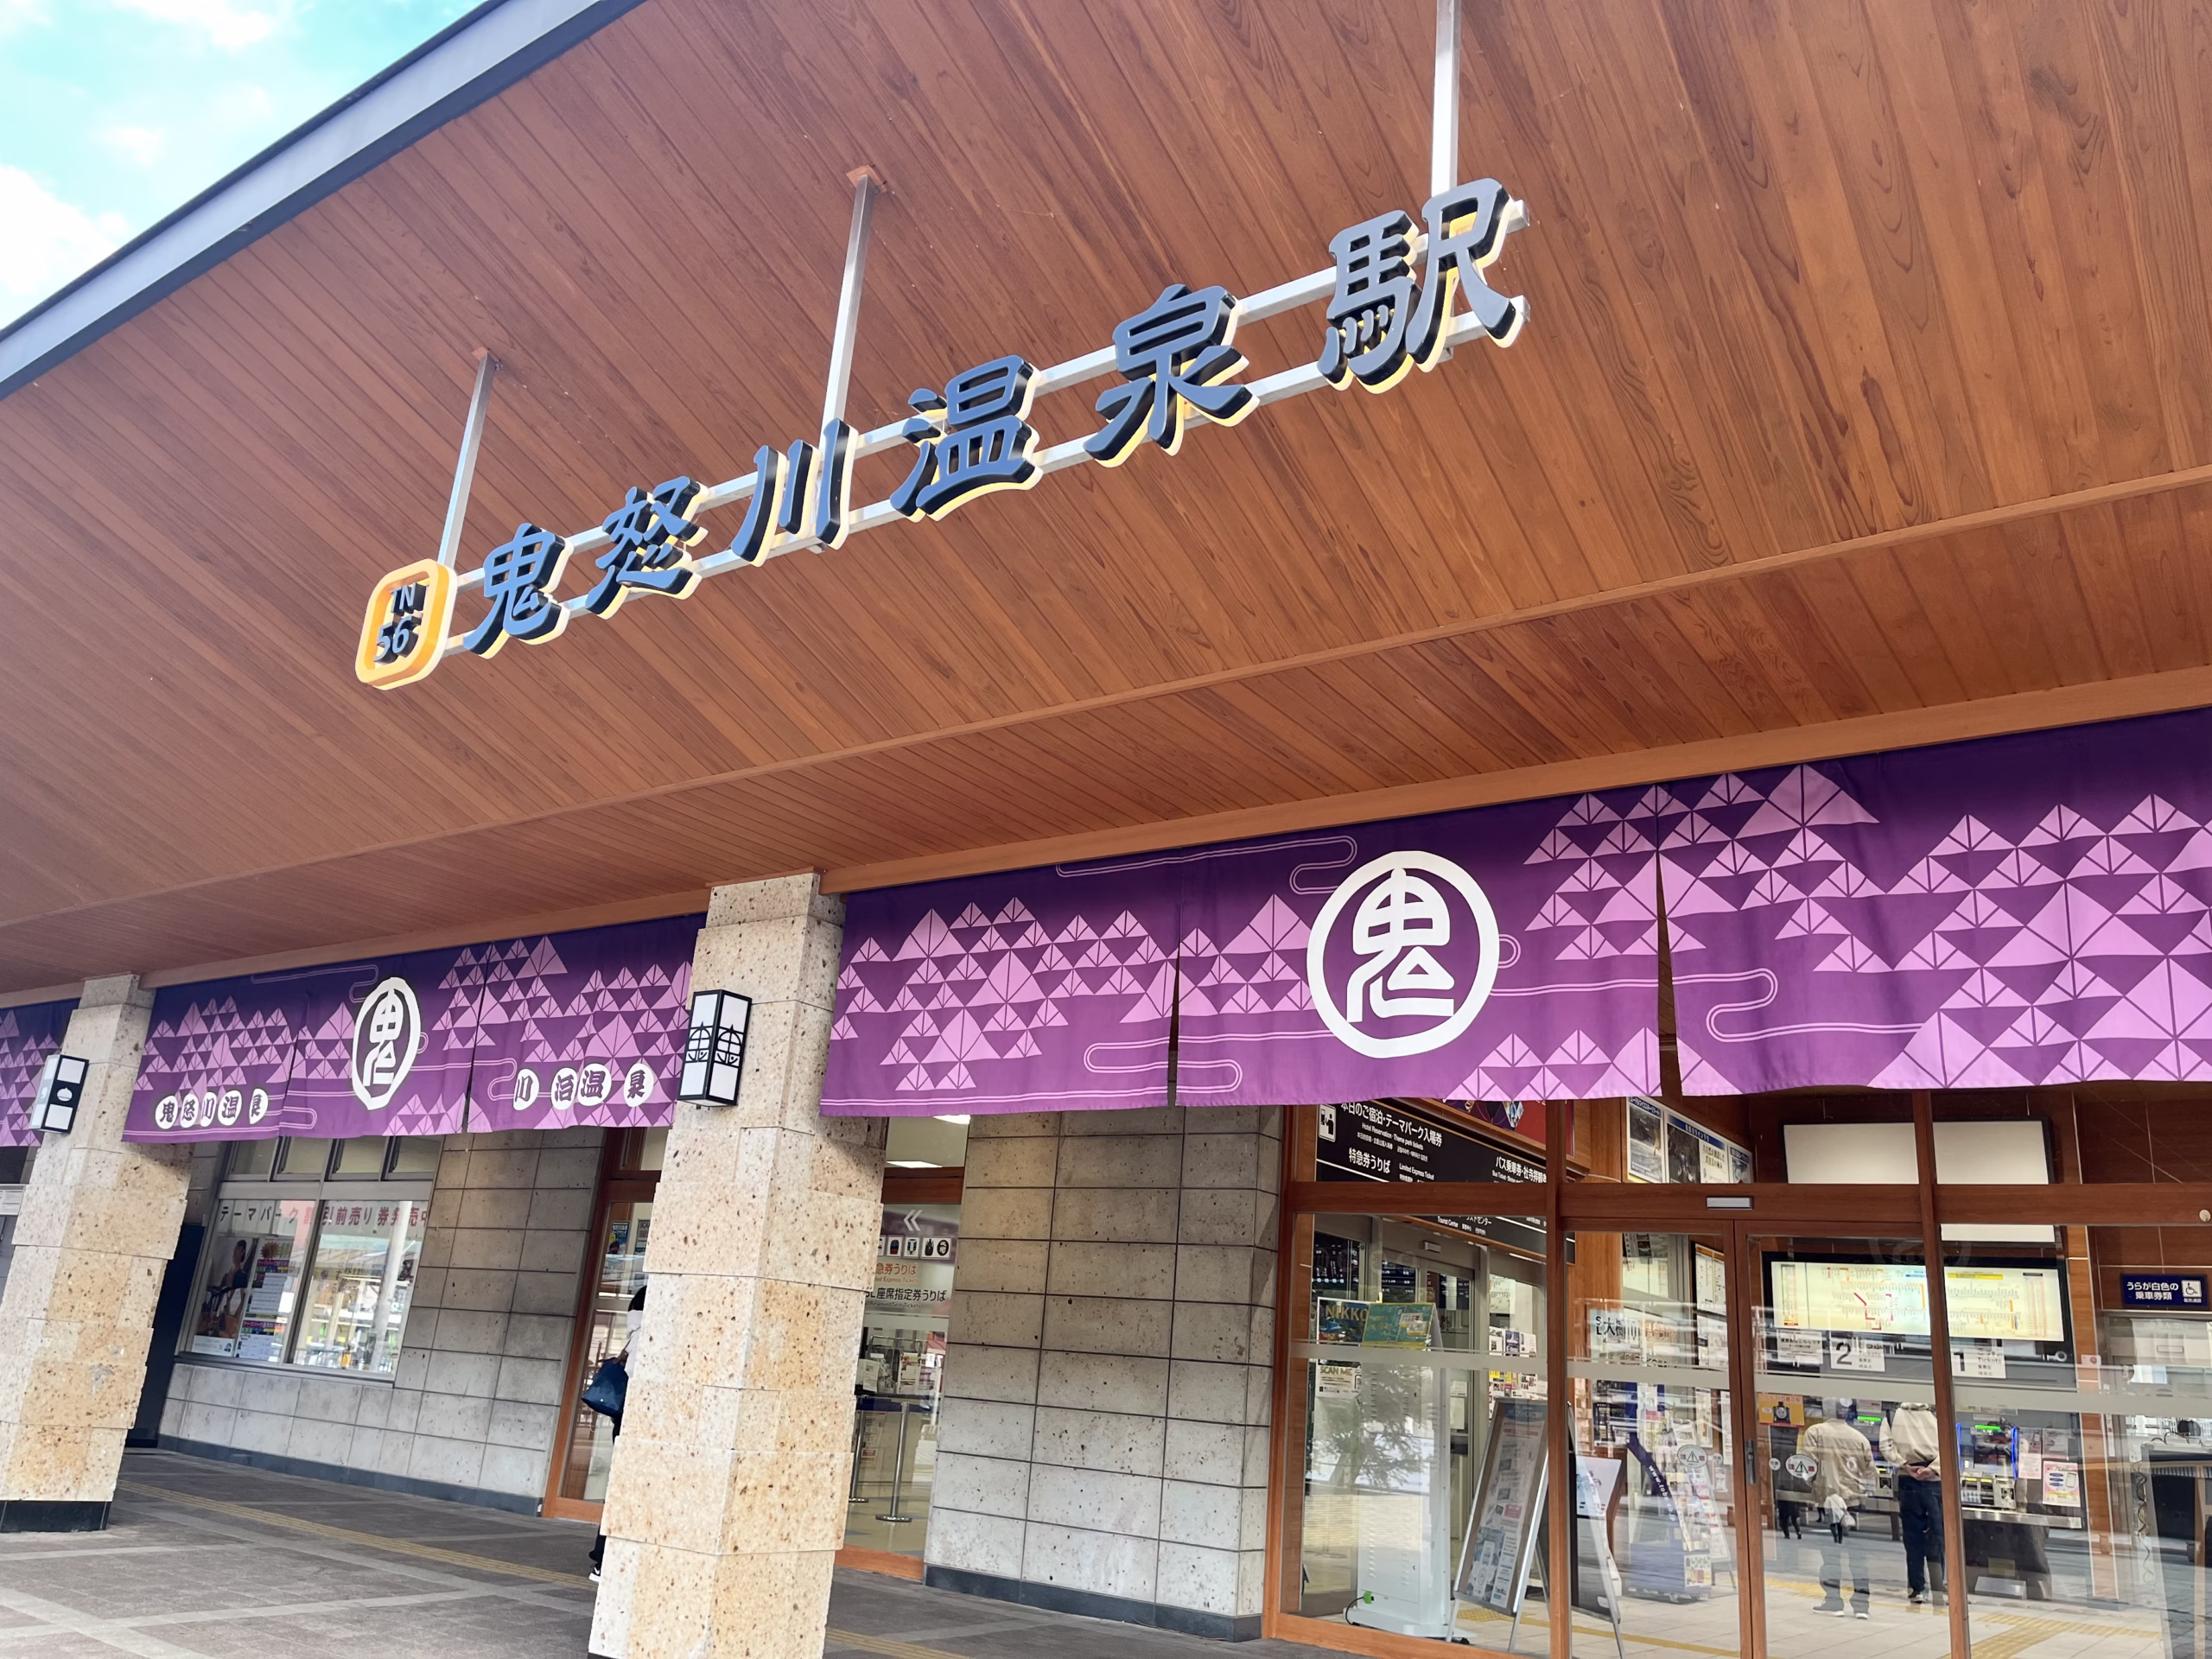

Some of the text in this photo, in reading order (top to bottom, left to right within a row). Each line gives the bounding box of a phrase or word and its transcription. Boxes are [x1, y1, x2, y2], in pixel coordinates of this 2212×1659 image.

[463, 178, 1524, 660] 鬼怒川温泉駅
[390, 582, 427, 616] TN
[373, 615, 419, 664] 56
[1348, 1147, 1391, 1174] 特急券うりば
[876, 1287, 947, 1302] 座席指定券うりば
[2126, 1281, 2179, 1291] うらが白色の
[2135, 1291, 2172, 1300] 乗車券類
[1325, 1306, 1369, 1322] NIKKO
[1836, 1340, 1853, 1365] 2
[1954, 1351, 1966, 1372] 1
